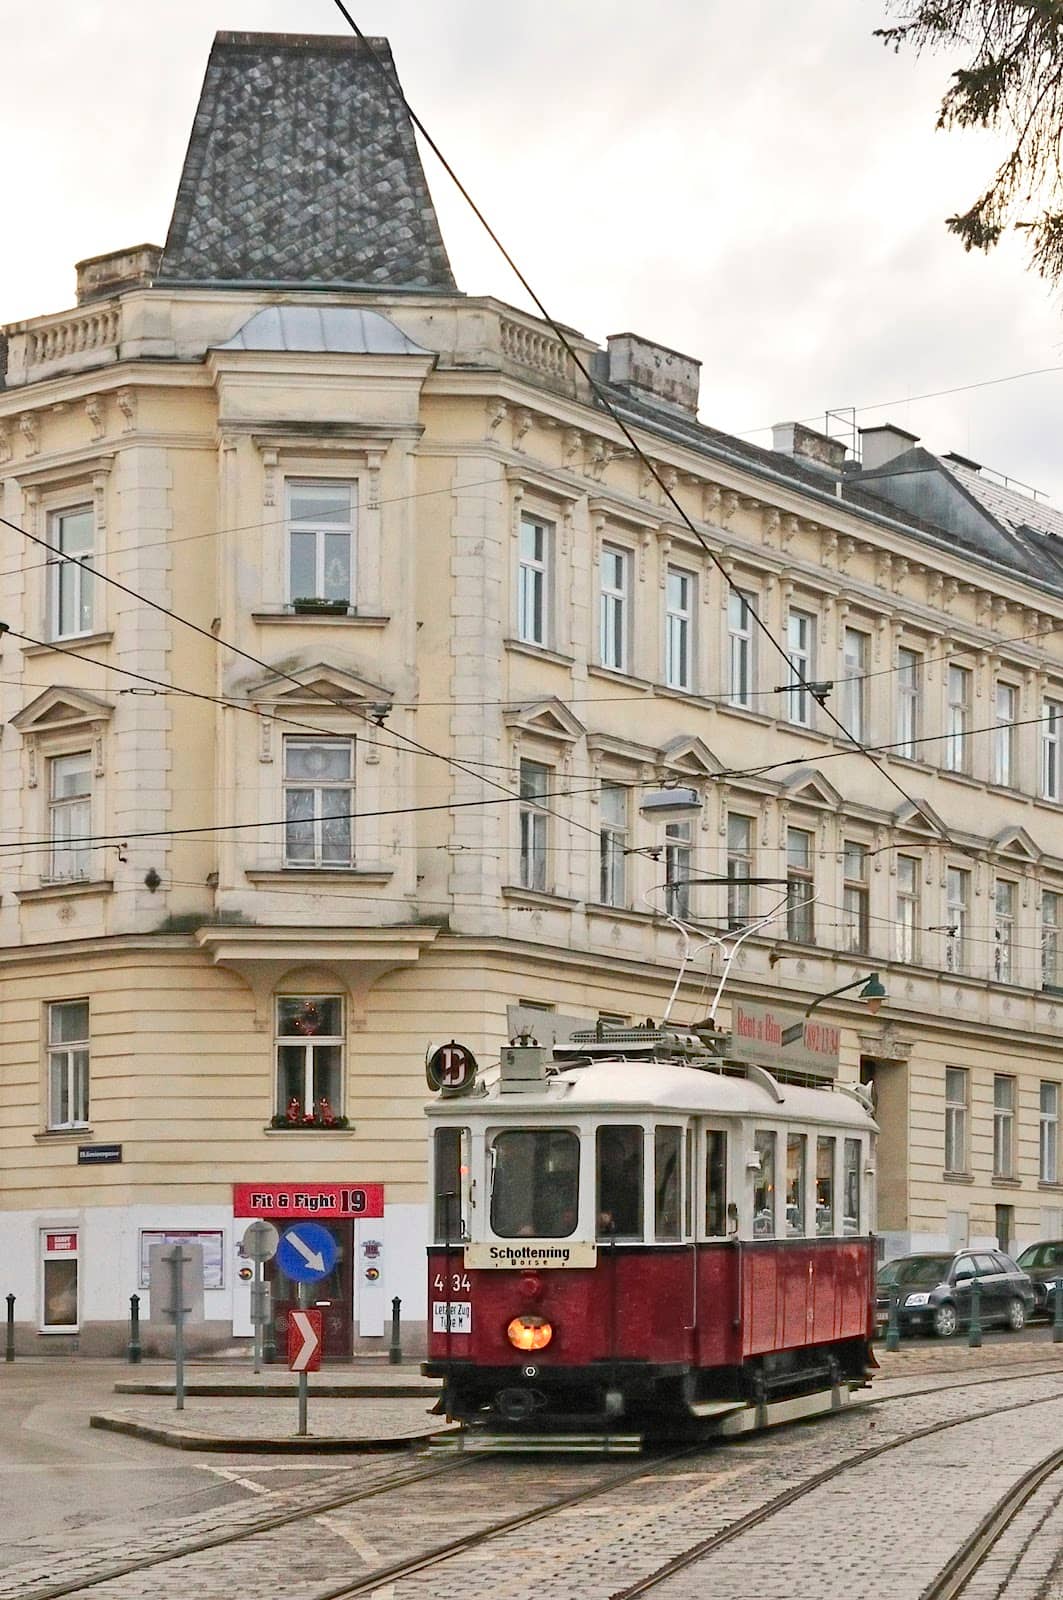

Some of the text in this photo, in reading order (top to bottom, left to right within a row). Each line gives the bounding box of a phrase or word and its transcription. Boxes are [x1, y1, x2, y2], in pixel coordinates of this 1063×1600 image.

[442, 1048, 466, 1086] D
[250, 1189, 367, 1213] Fit & Fight 19
[490, 1247, 570, 1261] Schottenring
[434, 1273, 471, 1292] 434
[458, 1304, 470, 1318] Zug
